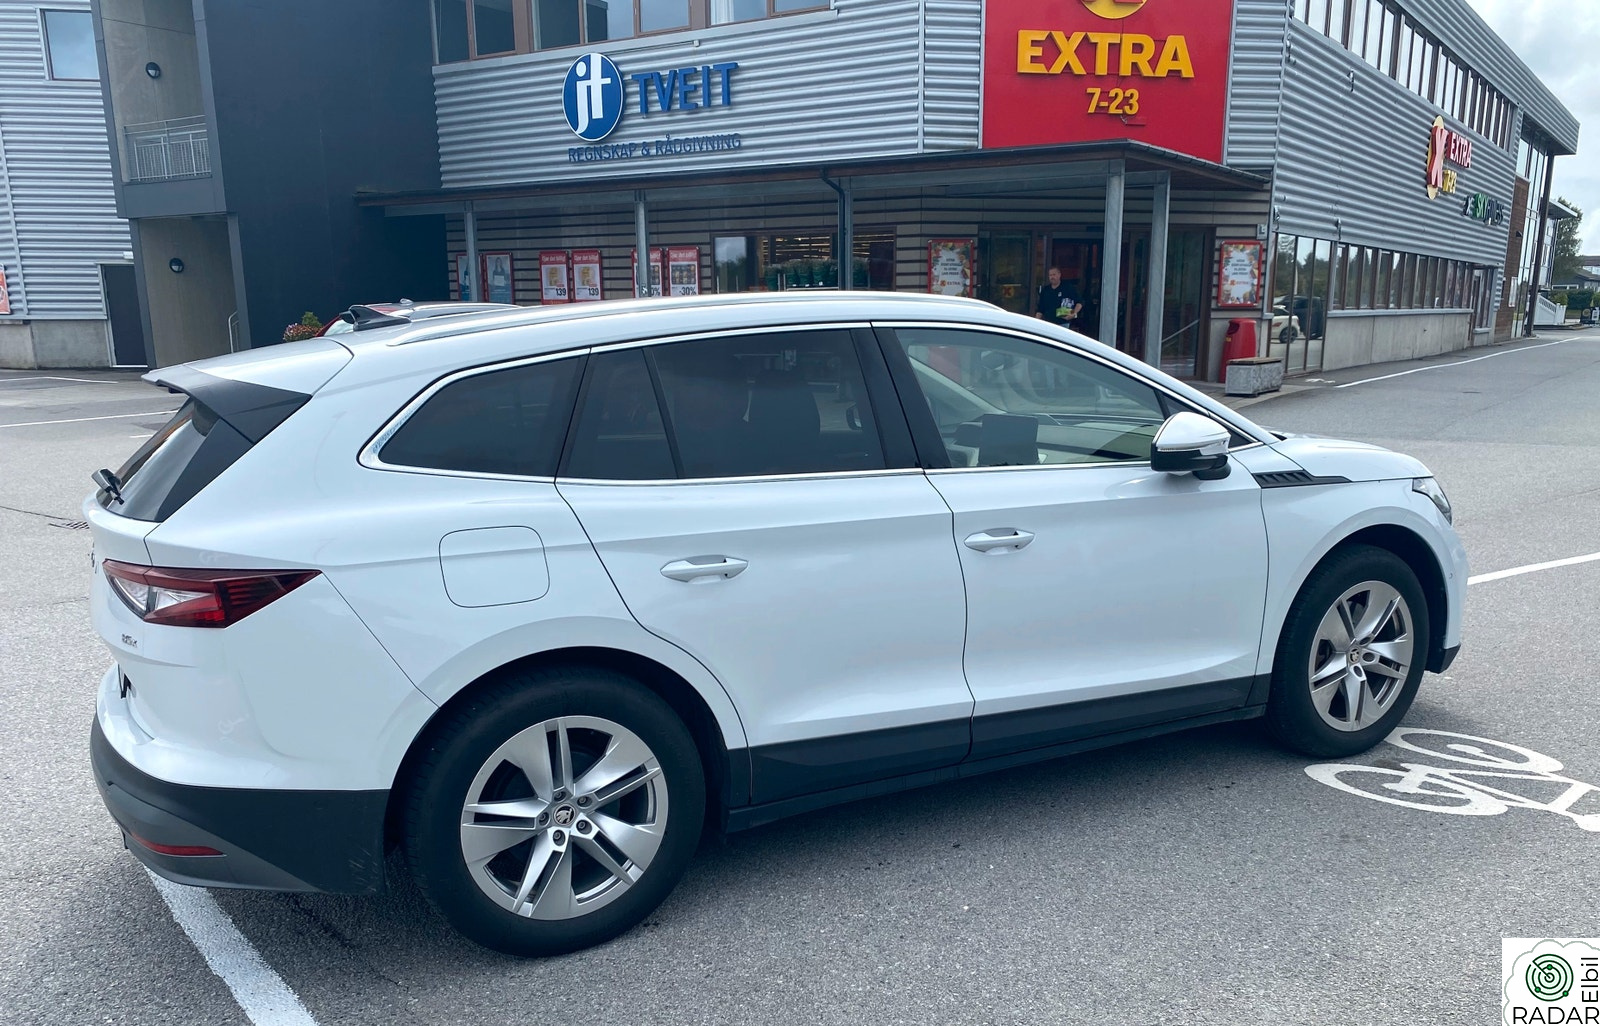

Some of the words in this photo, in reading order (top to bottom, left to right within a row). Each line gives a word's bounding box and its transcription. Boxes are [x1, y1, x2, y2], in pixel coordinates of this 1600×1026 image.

[1017, 29, 1194, 78] EXTRA
[631, 62, 739, 115] TVEIT
[1086, 87, 1139, 115] 7-23
[568, 142, 637, 163] REGNSKAP
[640, 141, 650, 156] &
[655, 133, 741, 156] RÅDGIVNING
[1449, 131, 1472, 168] EXTRA
[556, 287, 566, 296] 139
[588, 287, 599, 296] 139
[679, 286, 696, 296] -30%
